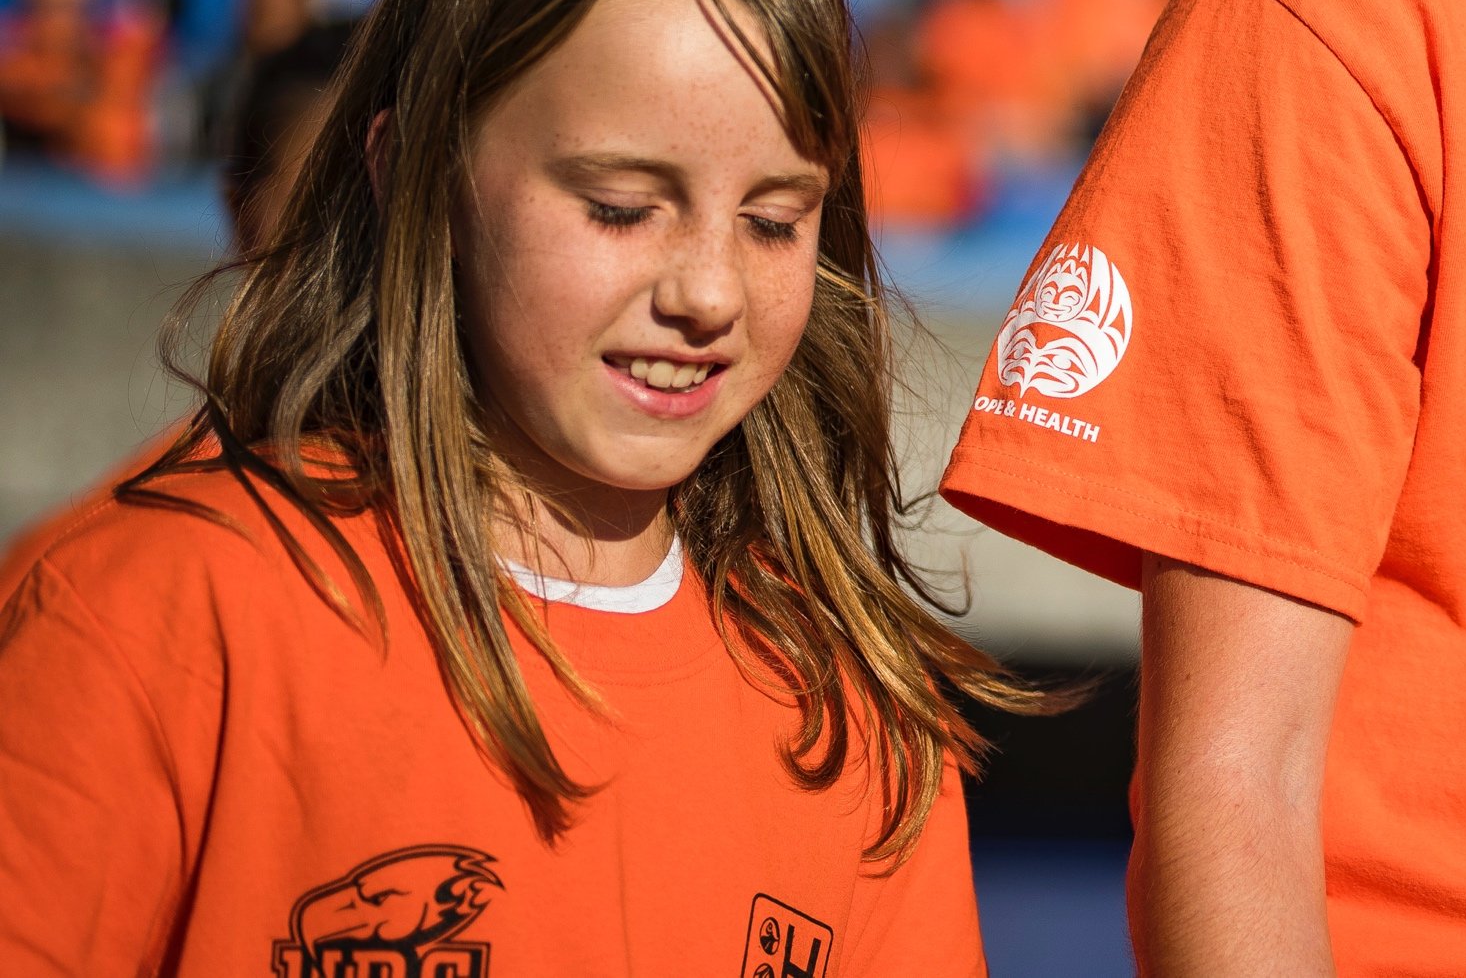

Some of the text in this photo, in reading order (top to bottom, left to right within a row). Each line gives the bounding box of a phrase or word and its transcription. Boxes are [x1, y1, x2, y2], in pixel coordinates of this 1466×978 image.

[974, 396, 1100, 442] OPE & HEALTH
